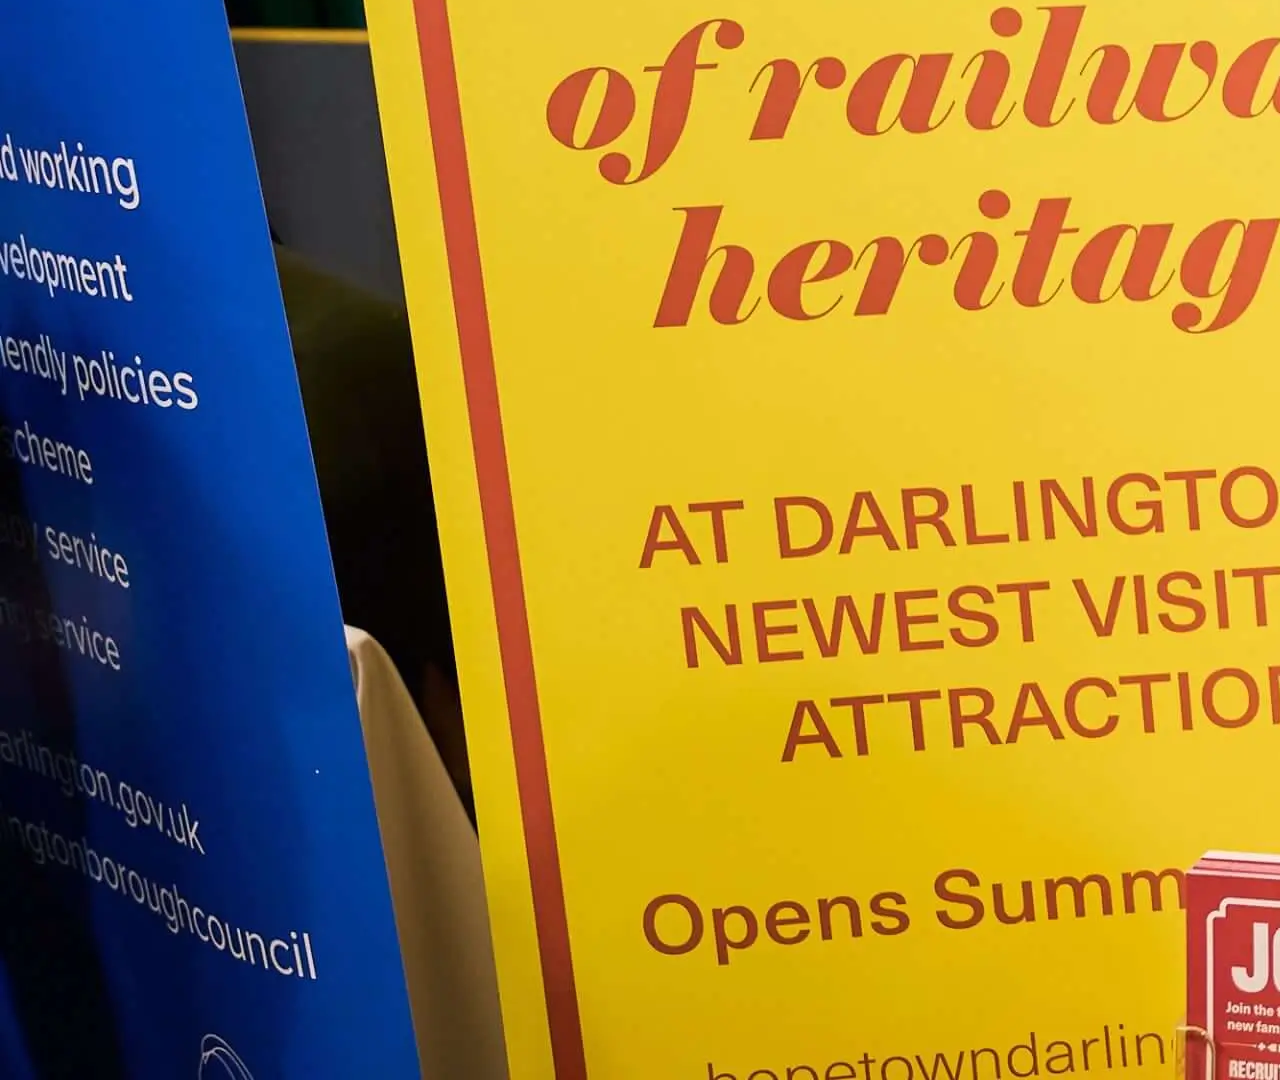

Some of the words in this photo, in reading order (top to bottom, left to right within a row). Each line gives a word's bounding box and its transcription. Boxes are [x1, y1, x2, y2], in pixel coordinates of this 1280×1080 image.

[545, 18, 744, 186] of
[19, 141, 140, 209] working
[72, 350, 199, 410] policies
[45, 525, 130, 588] service
[637, 499, 744, 569] AT
[679, 581, 1052, 669] NEWEST
[642, 889, 910, 966] Opens
[1226, 1000, 1250, 1015] Join
[1253, 1004, 1274, 1017] the
[1227, 1021, 1253, 1032] new
